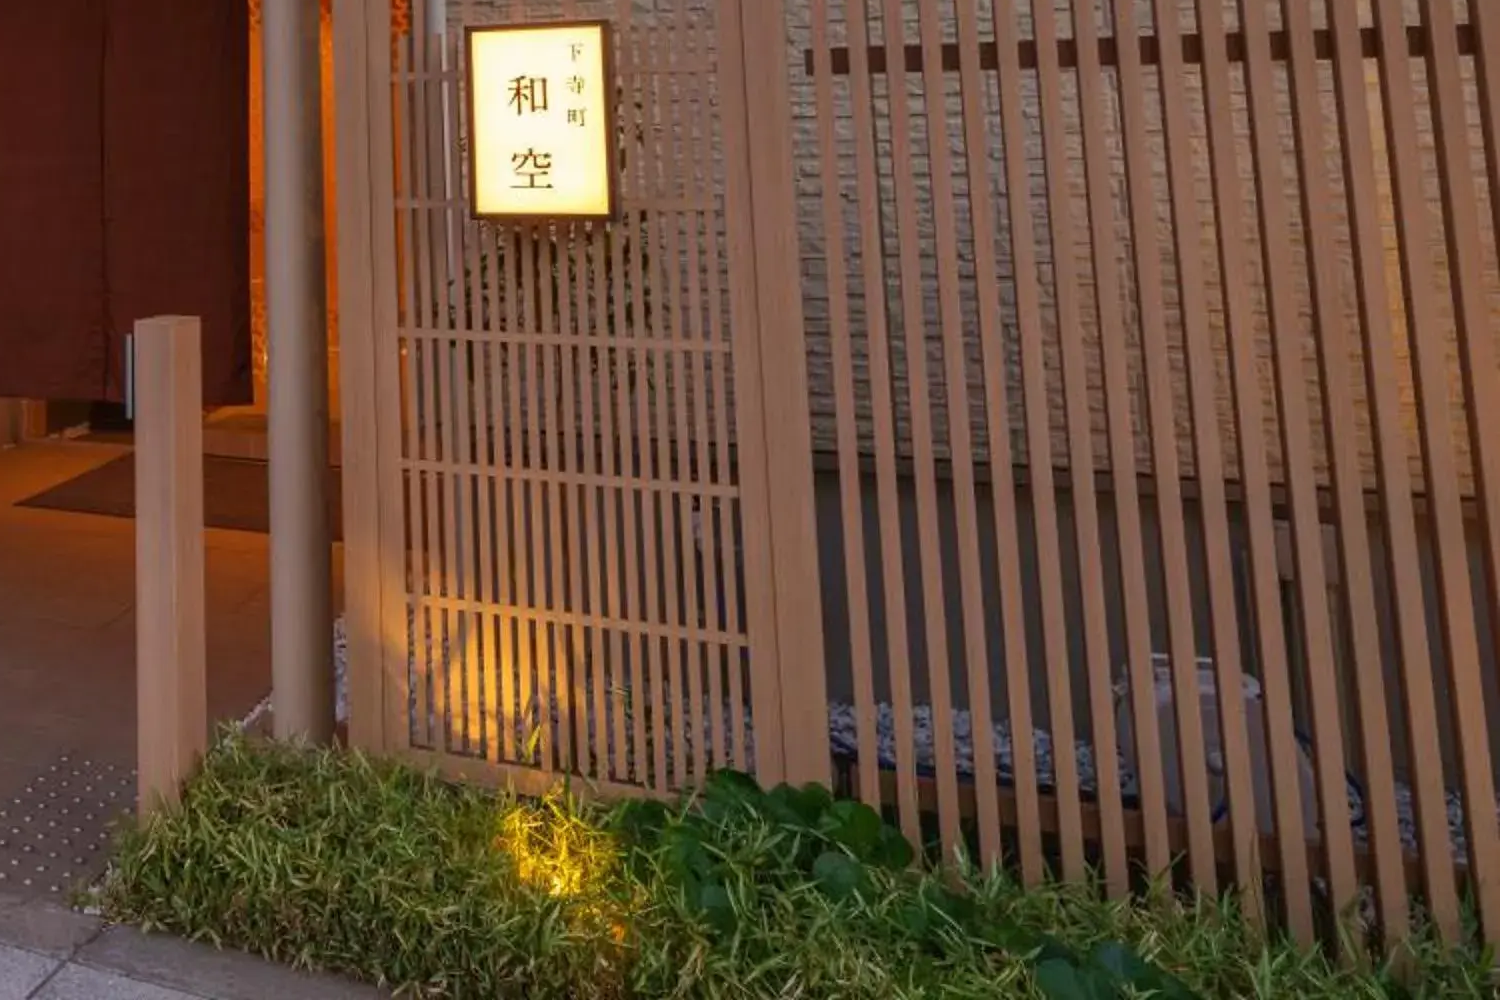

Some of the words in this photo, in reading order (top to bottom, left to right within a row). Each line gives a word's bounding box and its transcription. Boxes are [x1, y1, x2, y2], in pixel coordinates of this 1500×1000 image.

[507, 72, 554, 189] 和空
[566, 43, 587, 127] 下寺町
